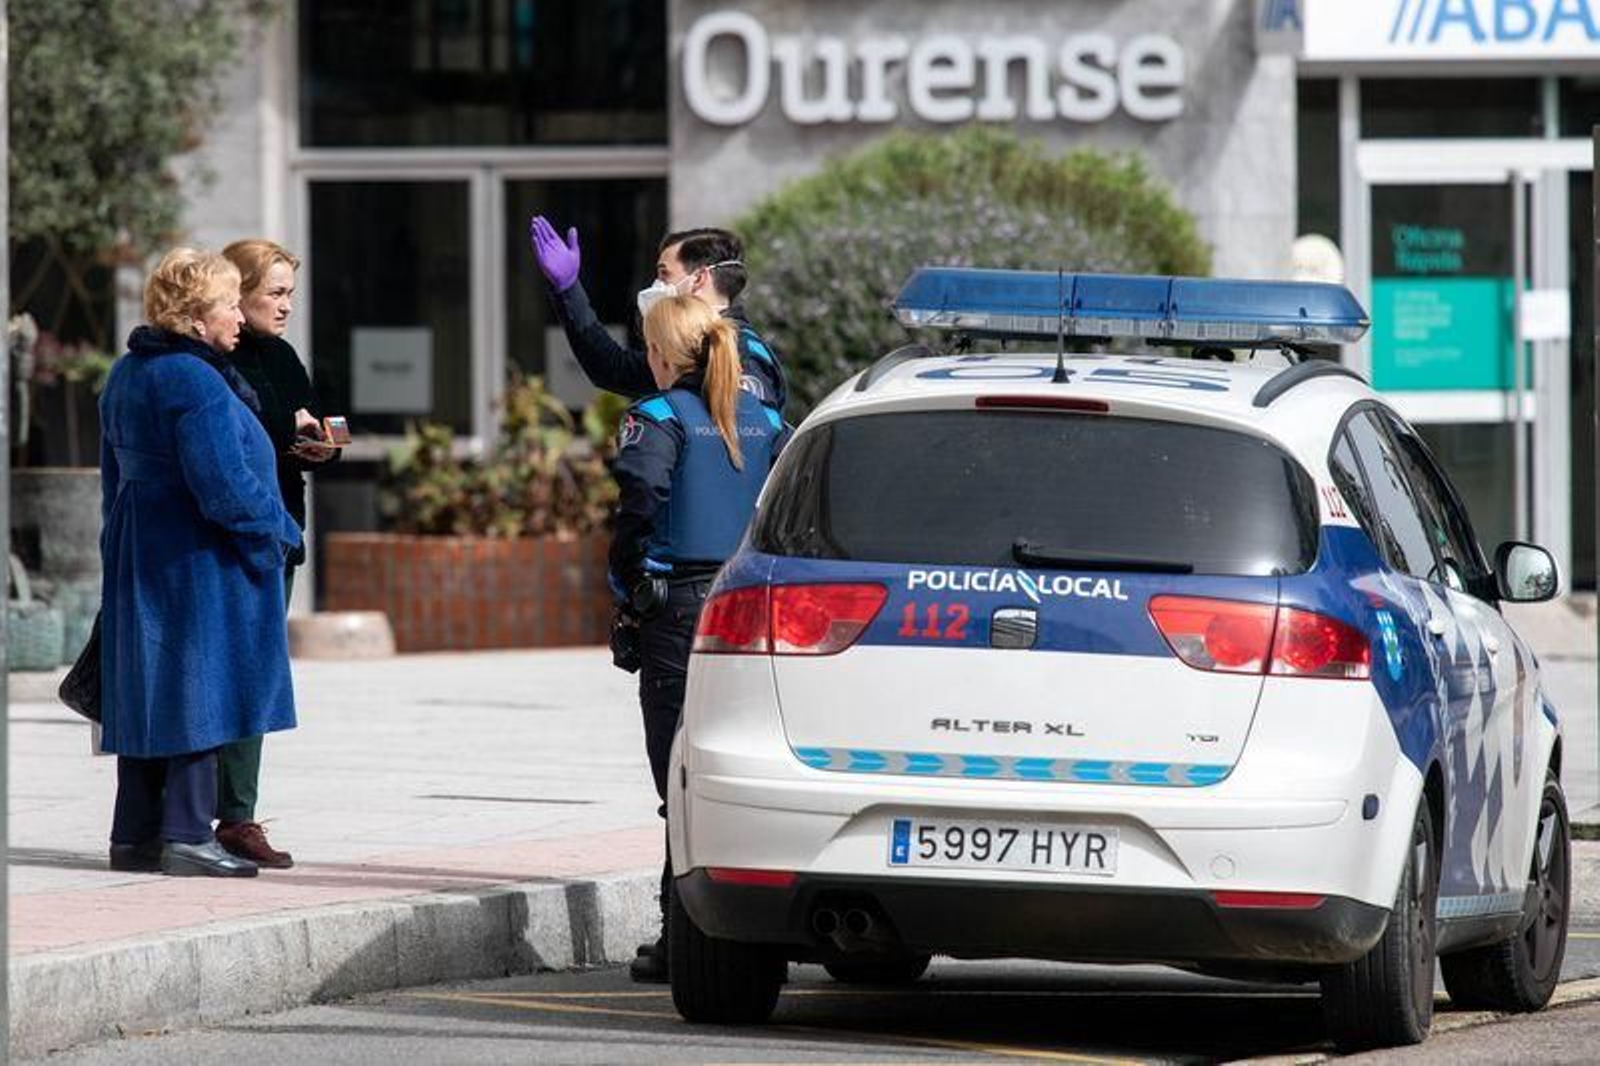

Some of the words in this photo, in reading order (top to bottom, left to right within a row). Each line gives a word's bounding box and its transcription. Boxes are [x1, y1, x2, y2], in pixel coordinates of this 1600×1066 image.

[683, 12, 1186, 125] Ourense
[907, 569, 1018, 592] POLICÍA
[1038, 574, 1129, 601] LOCAL
[898, 602, 970, 640] 112
[931, 717, 1033, 735] ALTER
[1044, 723, 1085, 737] XL
[918, 825, 1020, 865] 5997
[1031, 830, 1108, 869] HYR
